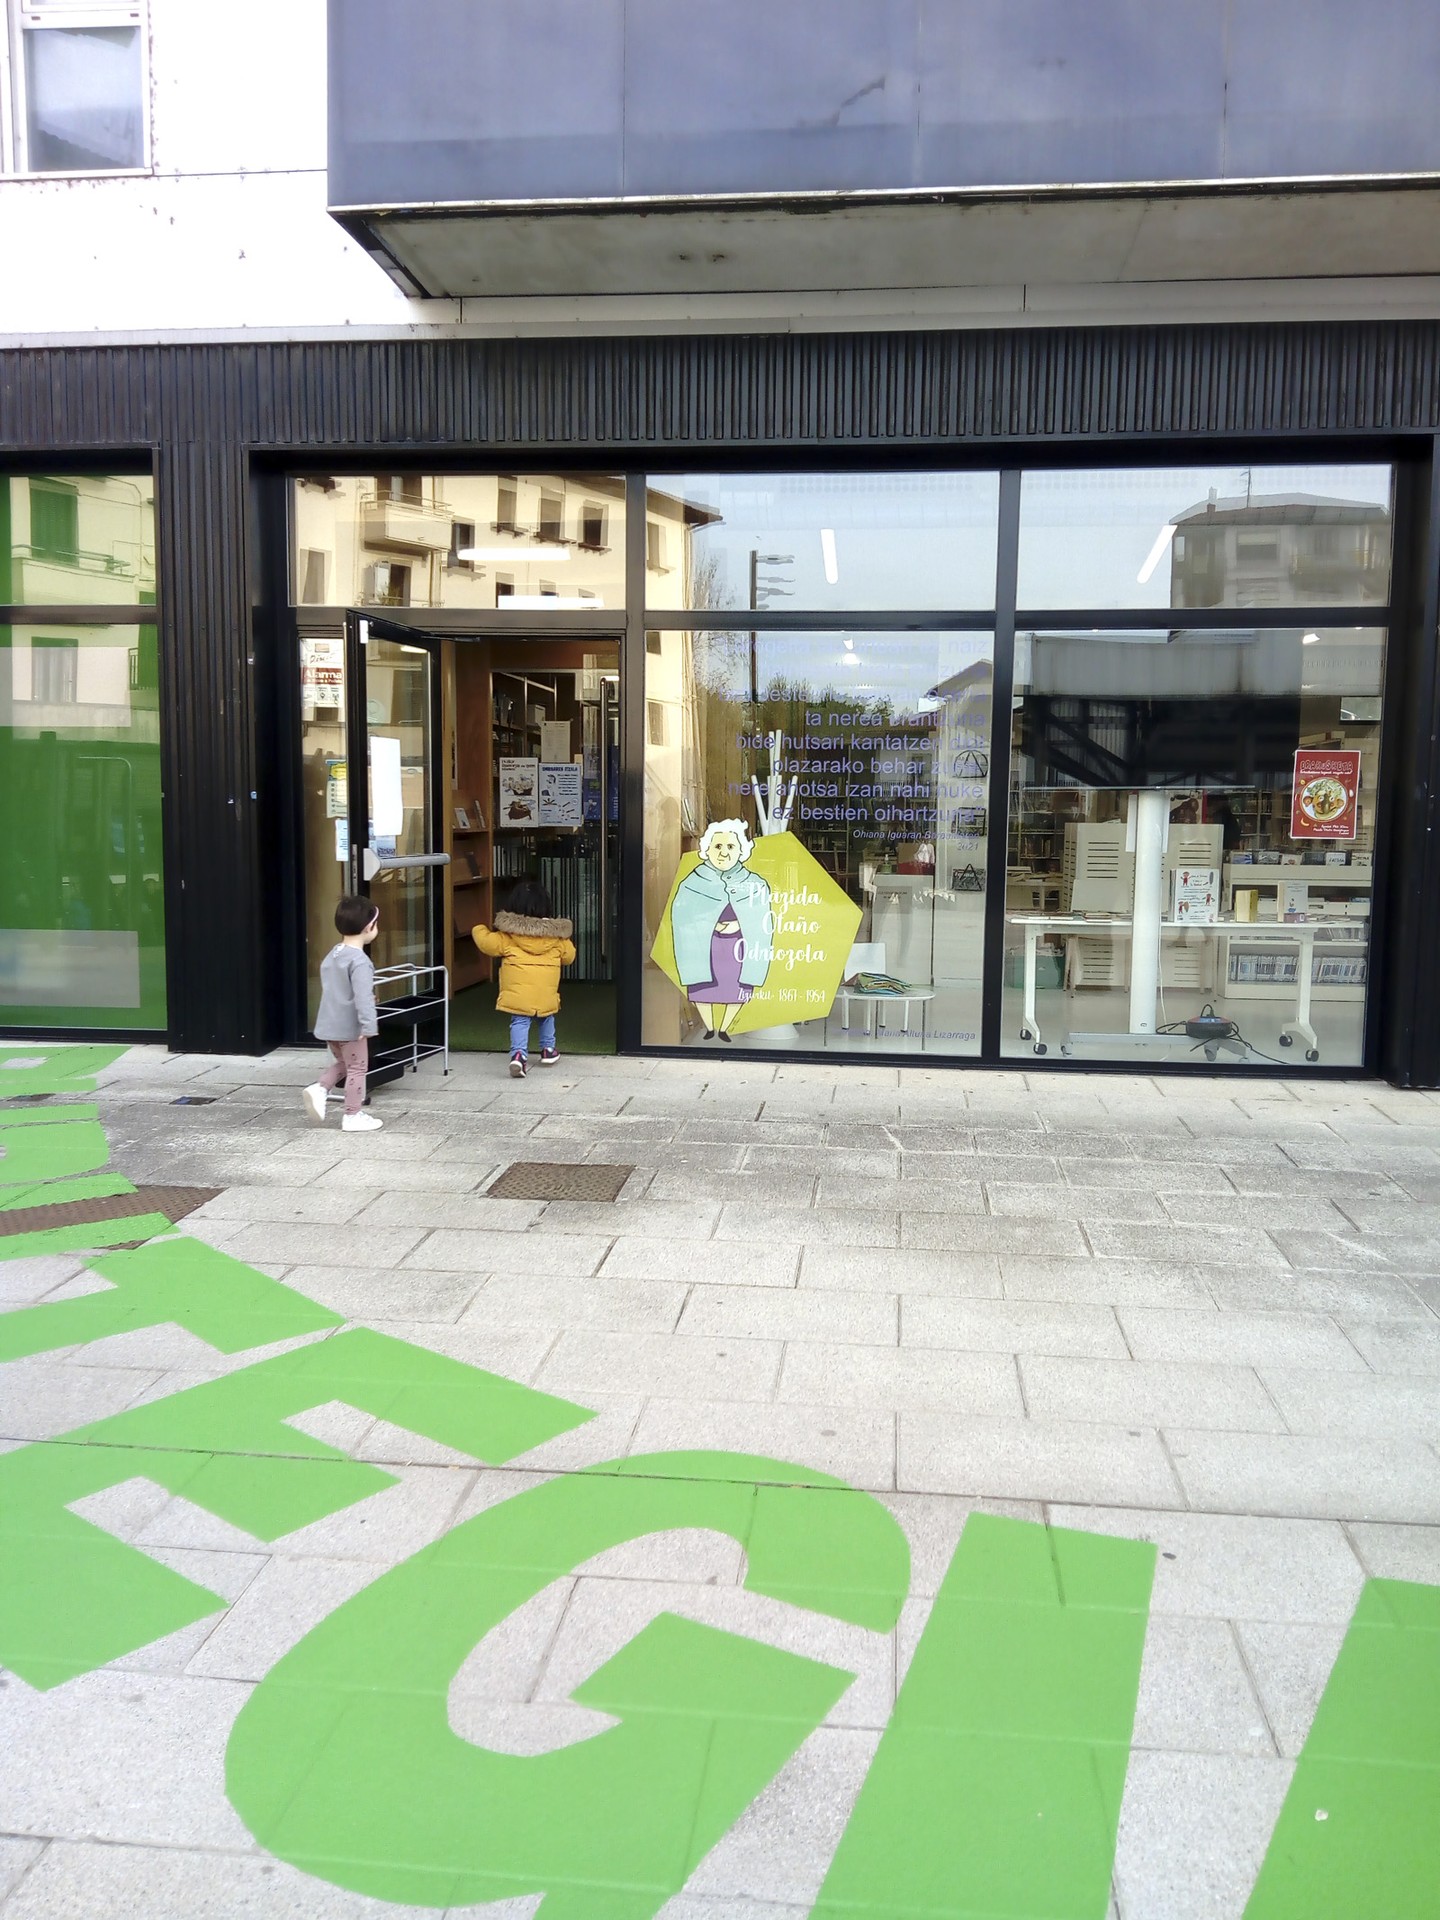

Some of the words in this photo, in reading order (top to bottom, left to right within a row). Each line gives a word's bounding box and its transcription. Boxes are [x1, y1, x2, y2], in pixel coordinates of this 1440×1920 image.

[805, 711, 822, 727] ta
[828, 712, 883, 728] nerea
[736, 734, 775, 750] bide
[781, 734, 845, 751] hutsari
[851, 734, 942, 751] kantatzen
[773, 758, 864, 777] plazarako
[871, 758, 925, 775] behar
[727, 782, 768, 797] nere
[777, 781, 838, 798] ahotsa
[845, 781, 883, 798] izan
[890, 781, 930, 798] nahi
[936, 781, 984, 798] nuke
[772, 807, 793, 821] ez
[801, 805, 868, 821] bestien
[887, 829, 922, 841] Iguaran
[762, 910, 821, 936] Otaño
[733, 938, 827, 971] Odriozola
[806, 989, 826, 1003] 1954
[933, 1030, 976, 1042] Lizarraga
